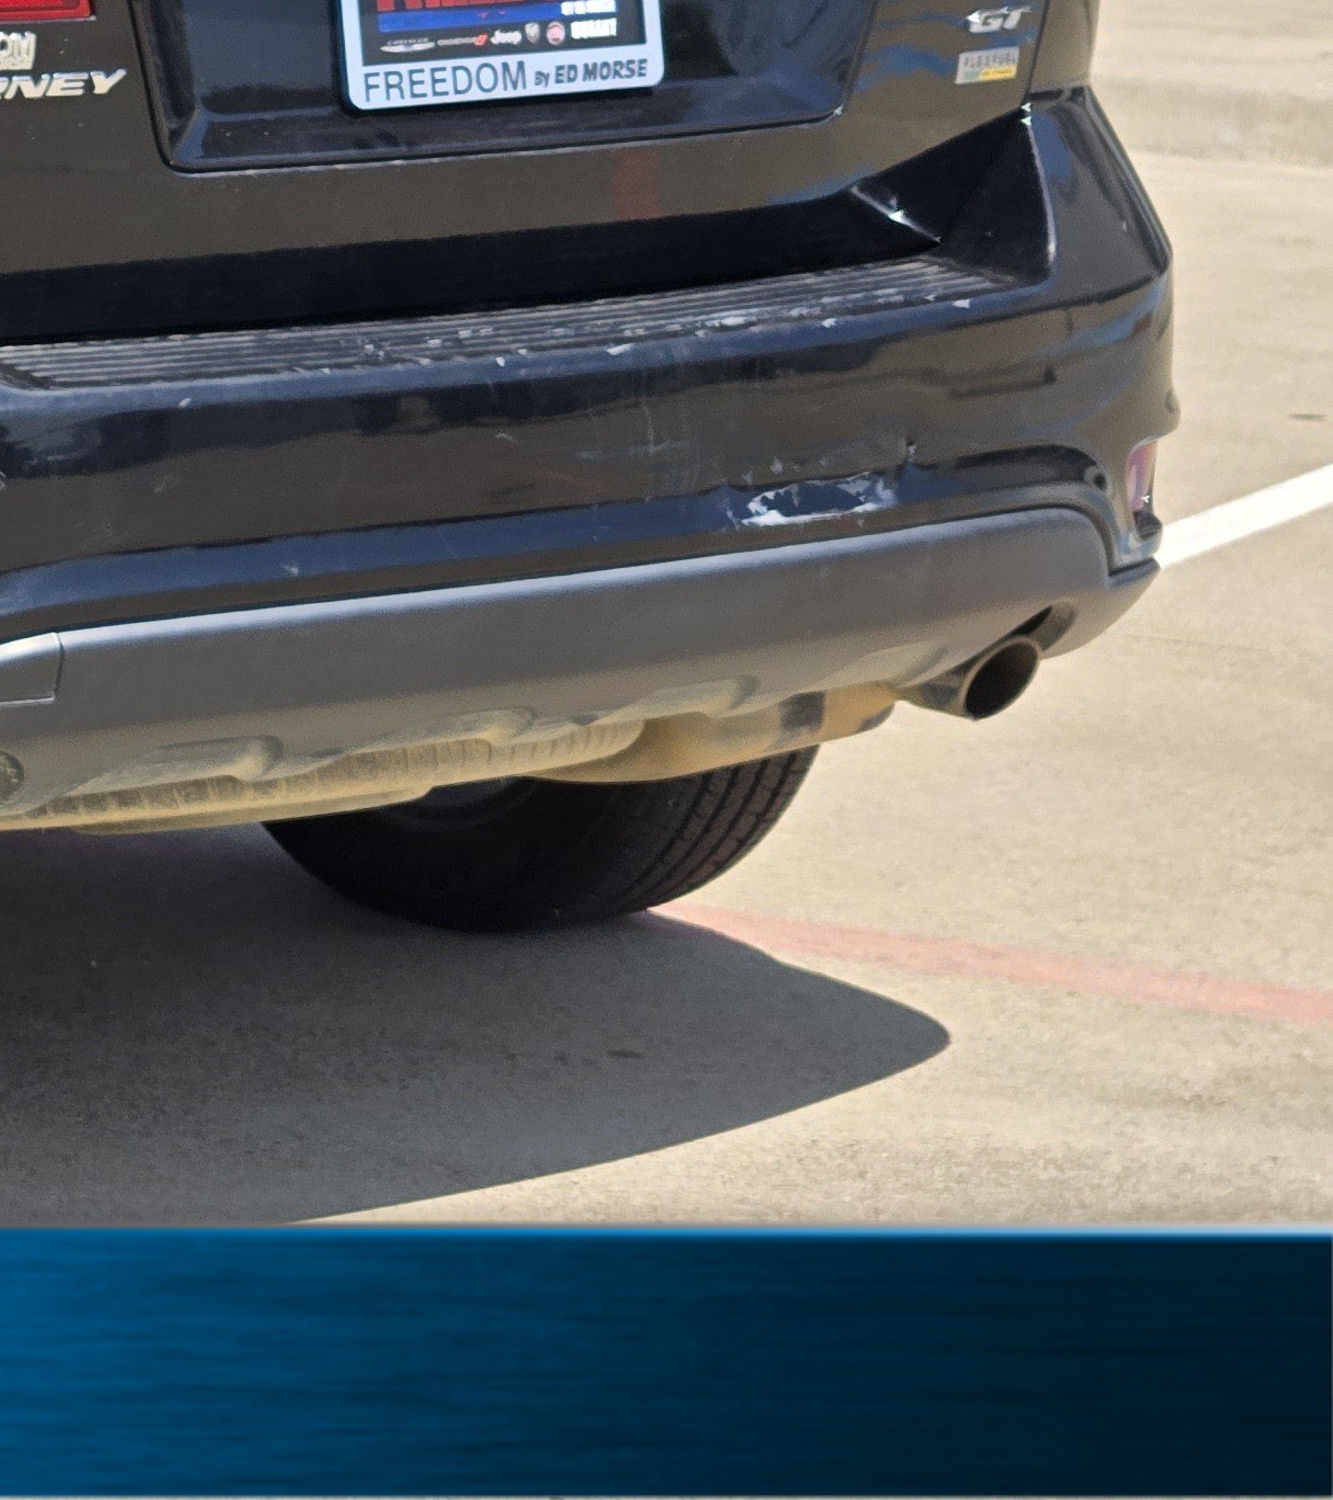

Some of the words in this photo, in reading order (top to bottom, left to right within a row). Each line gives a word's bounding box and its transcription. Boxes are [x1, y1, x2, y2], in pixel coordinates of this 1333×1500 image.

[965, 5, 1032, 33] GT
[362, 60, 527, 103] FREEDOM
[553, 64, 579, 85] ED
[582, 58, 649, 82] MORSE
